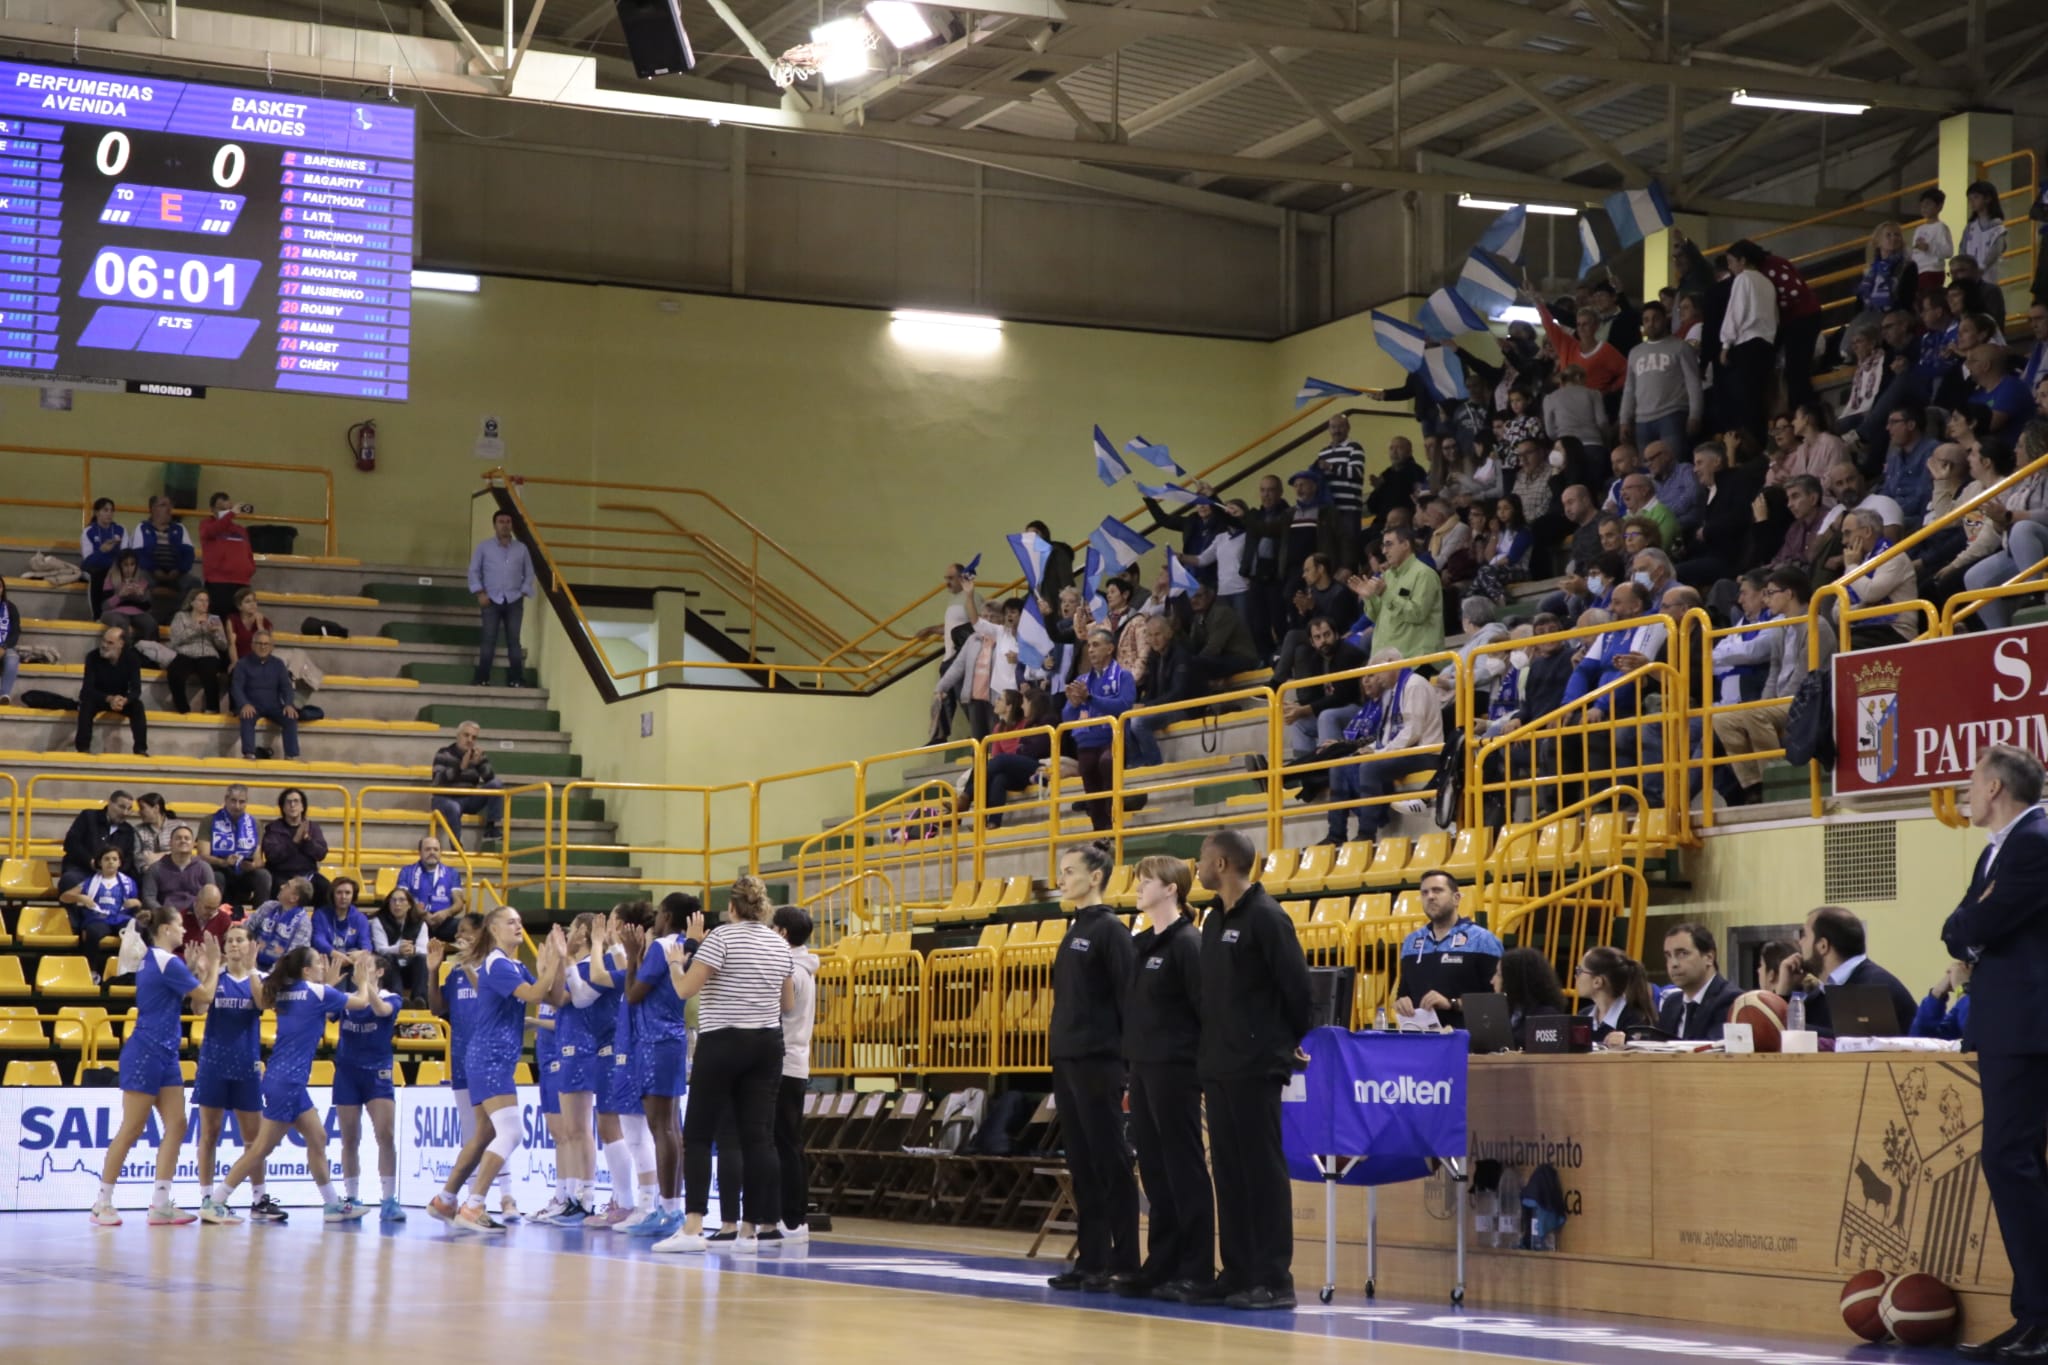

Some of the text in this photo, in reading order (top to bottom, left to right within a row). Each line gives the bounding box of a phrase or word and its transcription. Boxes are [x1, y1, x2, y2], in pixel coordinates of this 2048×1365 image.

[16, 72, 154, 101] PERFUMERIAS
[42, 94, 127, 117] AVENIDA
[231, 97, 307, 119] BASKET
[231, 115, 306, 136] LANDES
[96, 131, 130, 176] 0
[212, 144, 245, 188] 0
[304, 155, 366, 171] BARENNES
[284, 171, 363, 189] 2 MAGARITY
[117, 189, 134, 200] TO
[284, 189, 365, 208] 4 FAUTHOUX
[160, 193, 183, 222] E
[219, 199, 236, 211] TO
[303, 210, 334, 223] LATIL
[303, 229, 364, 244] TURCINOVI
[284, 246, 358, 262] 12 MARRAST
[95, 252, 236, 306] 06:01
[283, 264, 358, 281] 13 AKHATOR
[283, 282, 364, 300] 17 MUSIIENKO
[300, 303, 343, 316] ROUMY
[158, 316, 193, 329] FLTS
[281, 319, 334, 334] 44 MANN
[281, 337, 339, 353] 74 PAGET
[299, 358, 339, 371] CHÉRY
[1636, 352, 1671, 376] GAP
[148, 384, 192, 397] MONDO
[1993, 636, 2048, 703] S
[1535, 1029, 1558, 1042] POSSE
[1353, 1076, 1451, 1105] molten
[1470, 1131, 1583, 1168] Ayuntamiento
[1680, 1230, 1798, 1252] www.aytosalamanca.com
